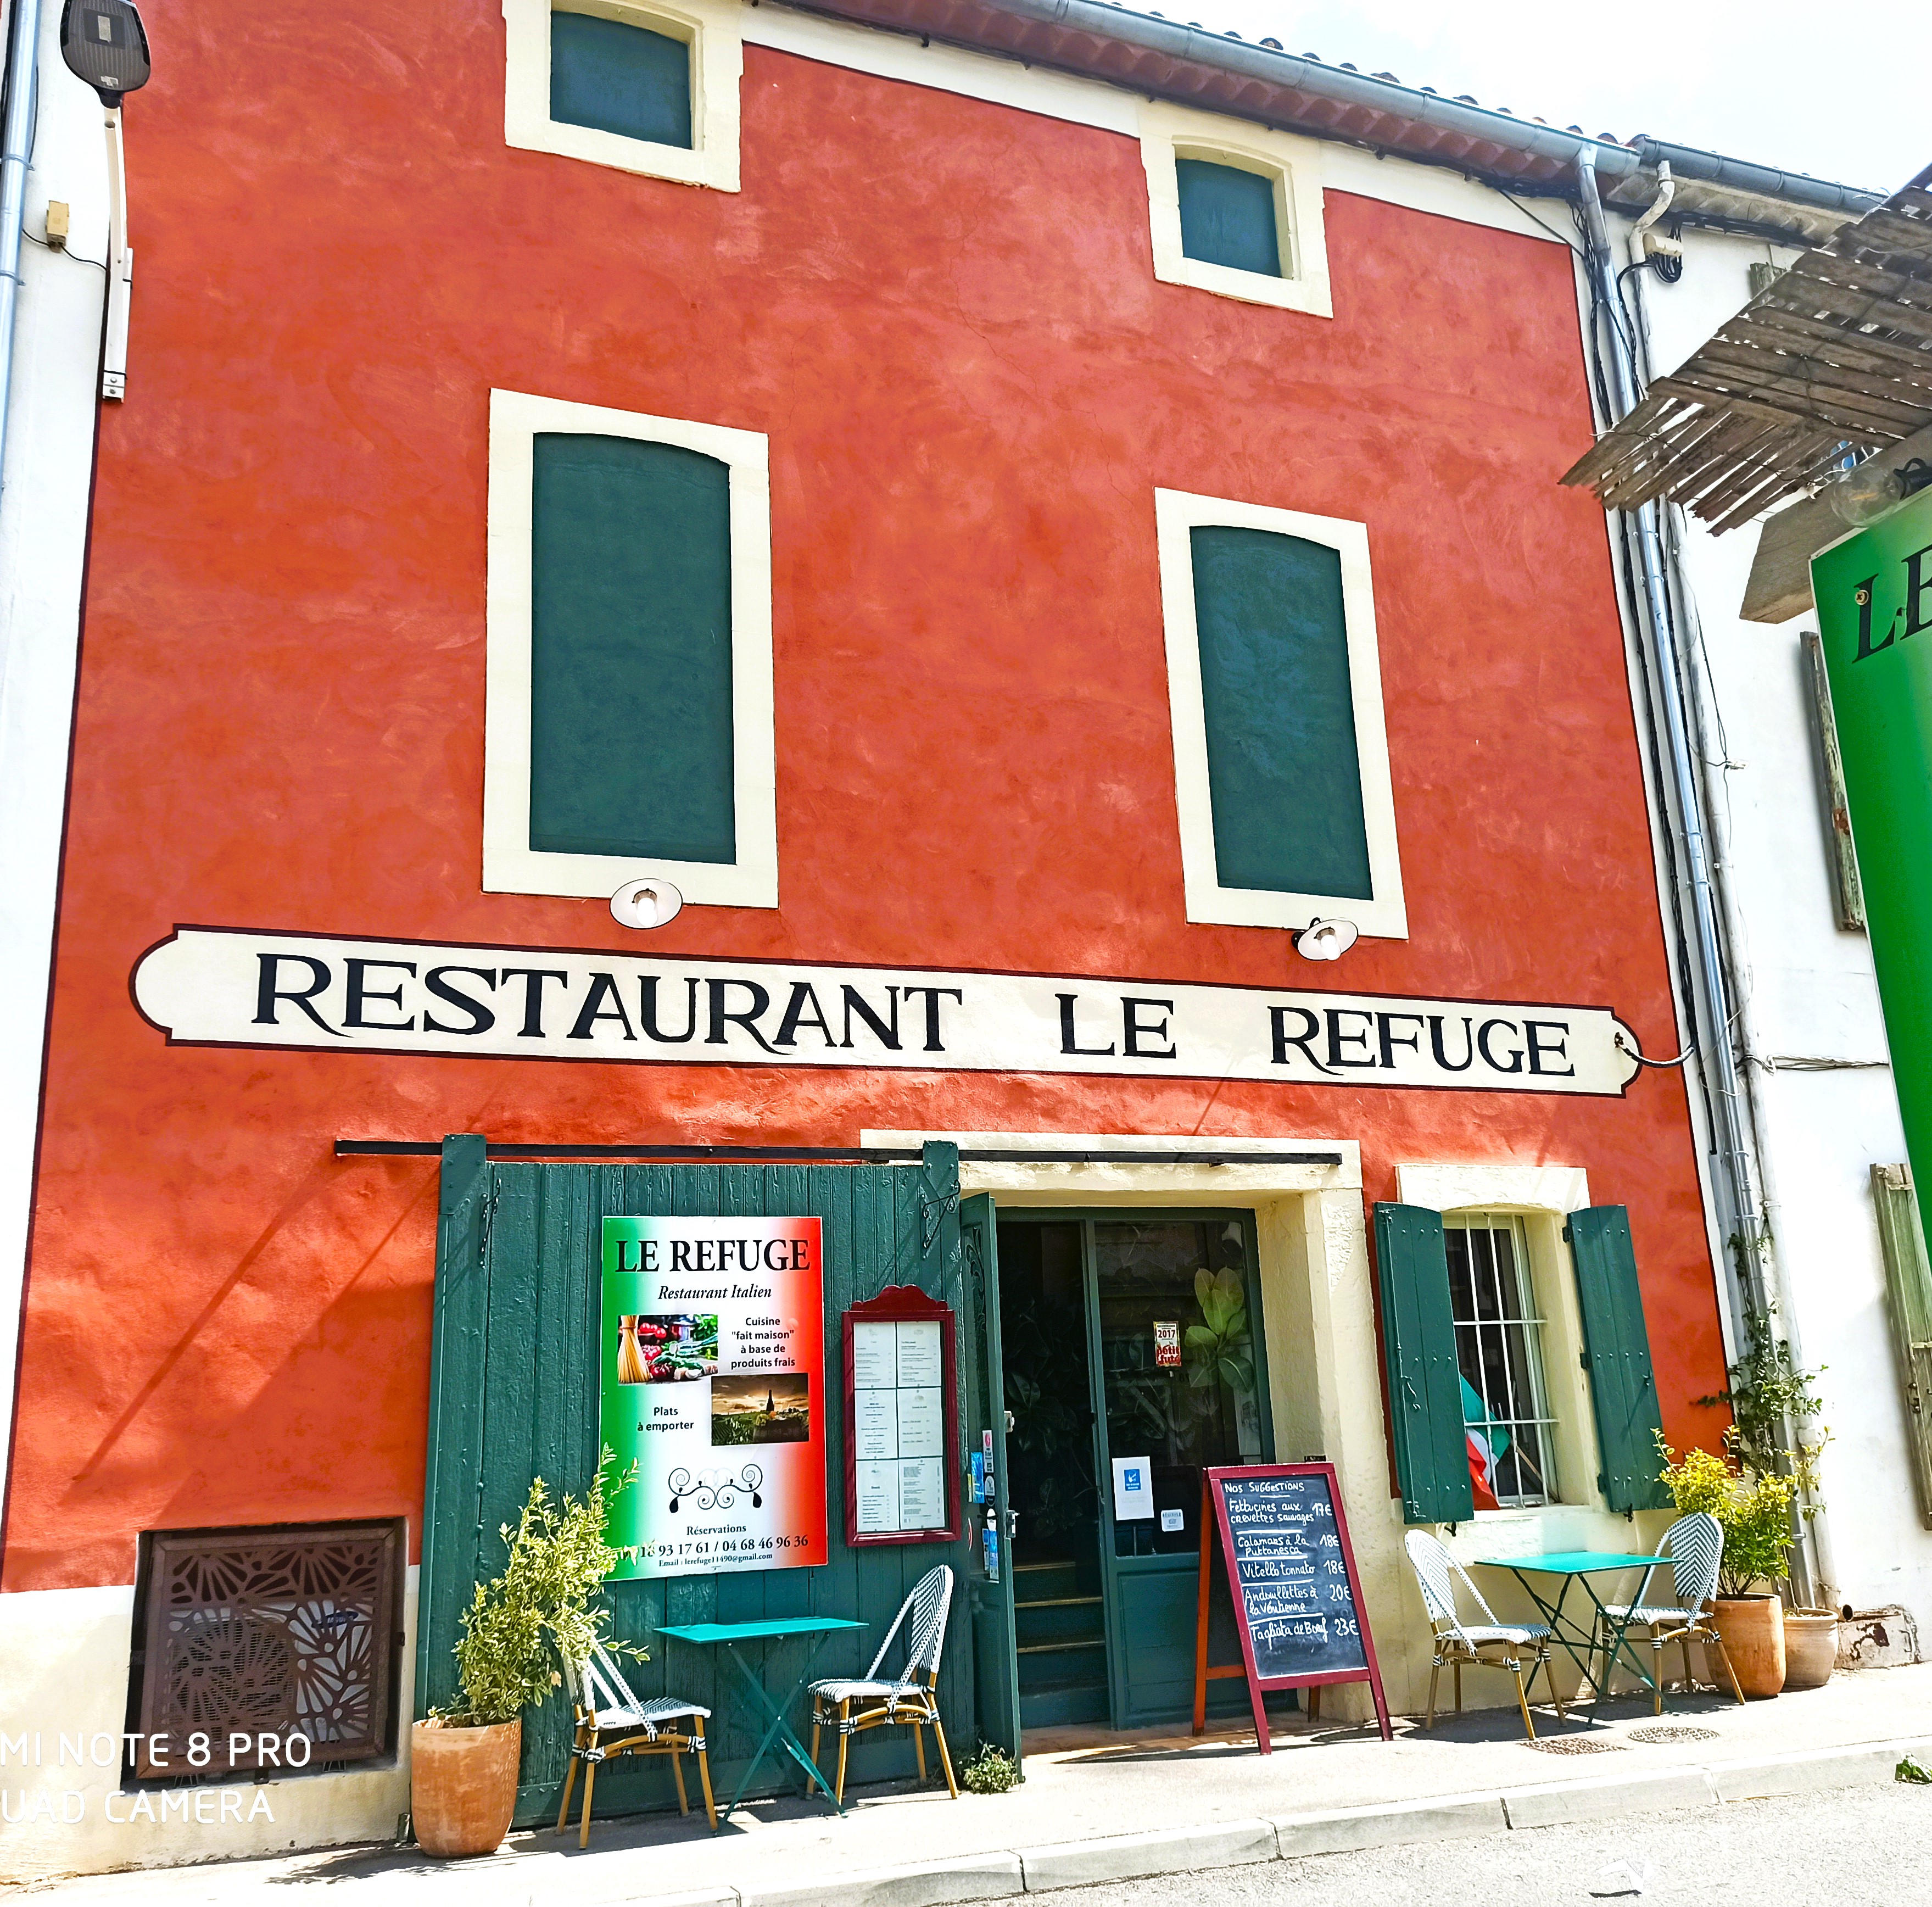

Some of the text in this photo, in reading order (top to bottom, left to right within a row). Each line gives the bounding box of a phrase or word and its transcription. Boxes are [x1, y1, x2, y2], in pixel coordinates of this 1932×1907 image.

[251, 953, 1575, 1077] RESTAURANT LE REFUGE
[615, 1239, 811, 1273] LE REFUGE
[658, 1284, 772, 1300] Restaurant Italien
[745, 1317, 780, 1326] Cuisine
[732, 1329, 794, 1340] "fait maison"
[1158, 1329, 1176, 1338] 2017
[740, 1343, 786, 1354] à base de
[731, 1357, 795, 1370] produits frais
[654, 1406, 678, 1416] Plats
[637, 1421, 694, 1432] à emporter
[1281, 1503, 1302, 1511] aux
[1311, 1502, 1333, 1516] 17€
[1277, 1513, 1315, 1526] sauvages
[686, 1524, 746, 1536] Réservations
[658, 1544, 673, 1557] 93
[678, 1543, 692, 1555] 17
[696, 1542, 709, 1554] 61
[722, 1539, 736, 1552] 04
[740, 1538, 755, 1551] 68
[758, 1536, 773, 1549] 46
[776, 1536, 791, 1548] 96
[794, 1535, 808, 1547] 36
[1285, 1535, 1293, 1546] à
[1294, 1534, 1310, 1547] la
[1319, 1534, 1340, 1548] 18€
[658, 1558, 679, 1567] Email
[685, 1553, 773, 1565] lerefuge11490@gmail.com
[1242, 1559, 1345, 1578] Vitello tonnato 18€
[1244, 1584, 1353, 1606] Andouillettes à 20€
[1250, 1620, 1293, 1650] Tagliata
[1334, 1617, 1359, 1637] 23€
